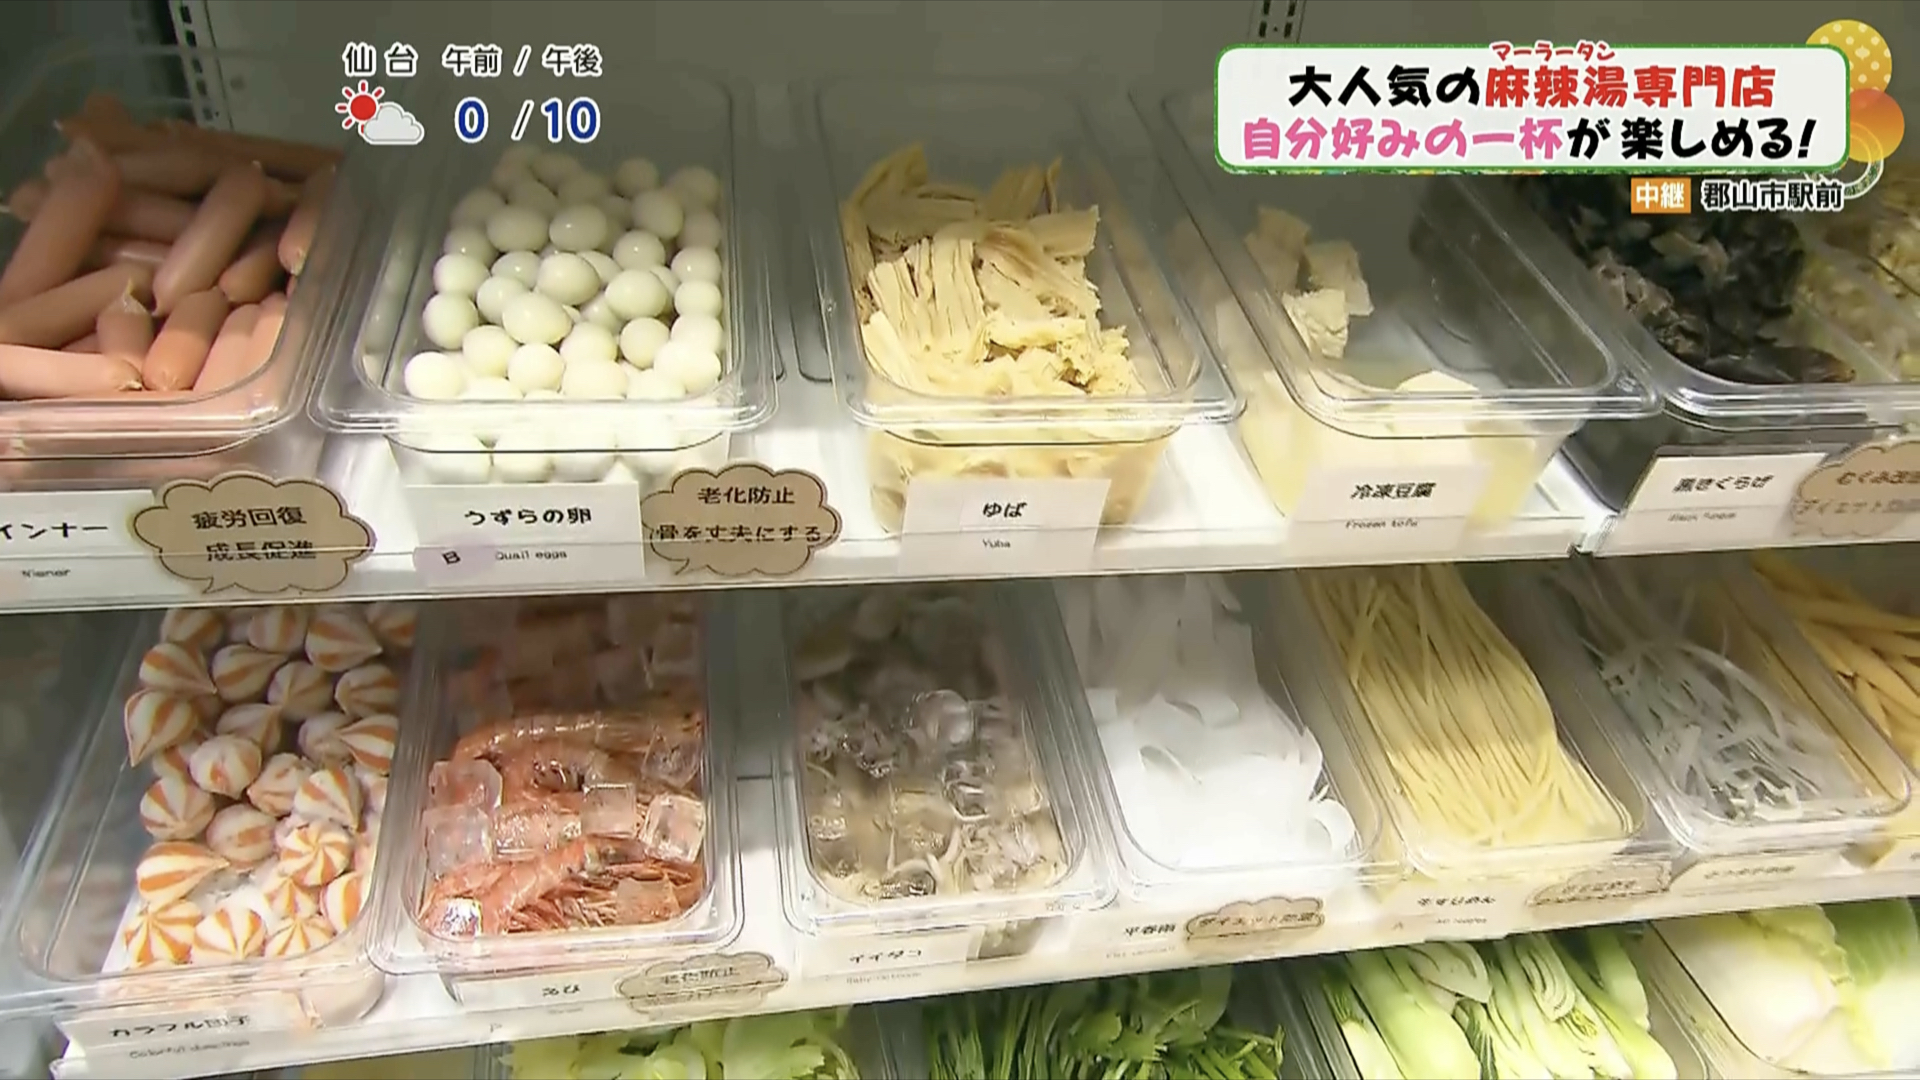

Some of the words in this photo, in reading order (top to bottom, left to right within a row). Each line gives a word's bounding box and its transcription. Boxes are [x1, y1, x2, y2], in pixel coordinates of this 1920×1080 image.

[698, 486, 796, 505] 老化防止
[1351, 482, 1436, 500] 冷凍豆腐
[191, 505, 308, 529] 疲労回復
[464, 507, 592, 526] うずらの卵
[982, 502, 1028, 518] ゆば
[656, 524, 822, 543] 骨を丈夫にする
[206, 540, 317, 562] 成長促進
